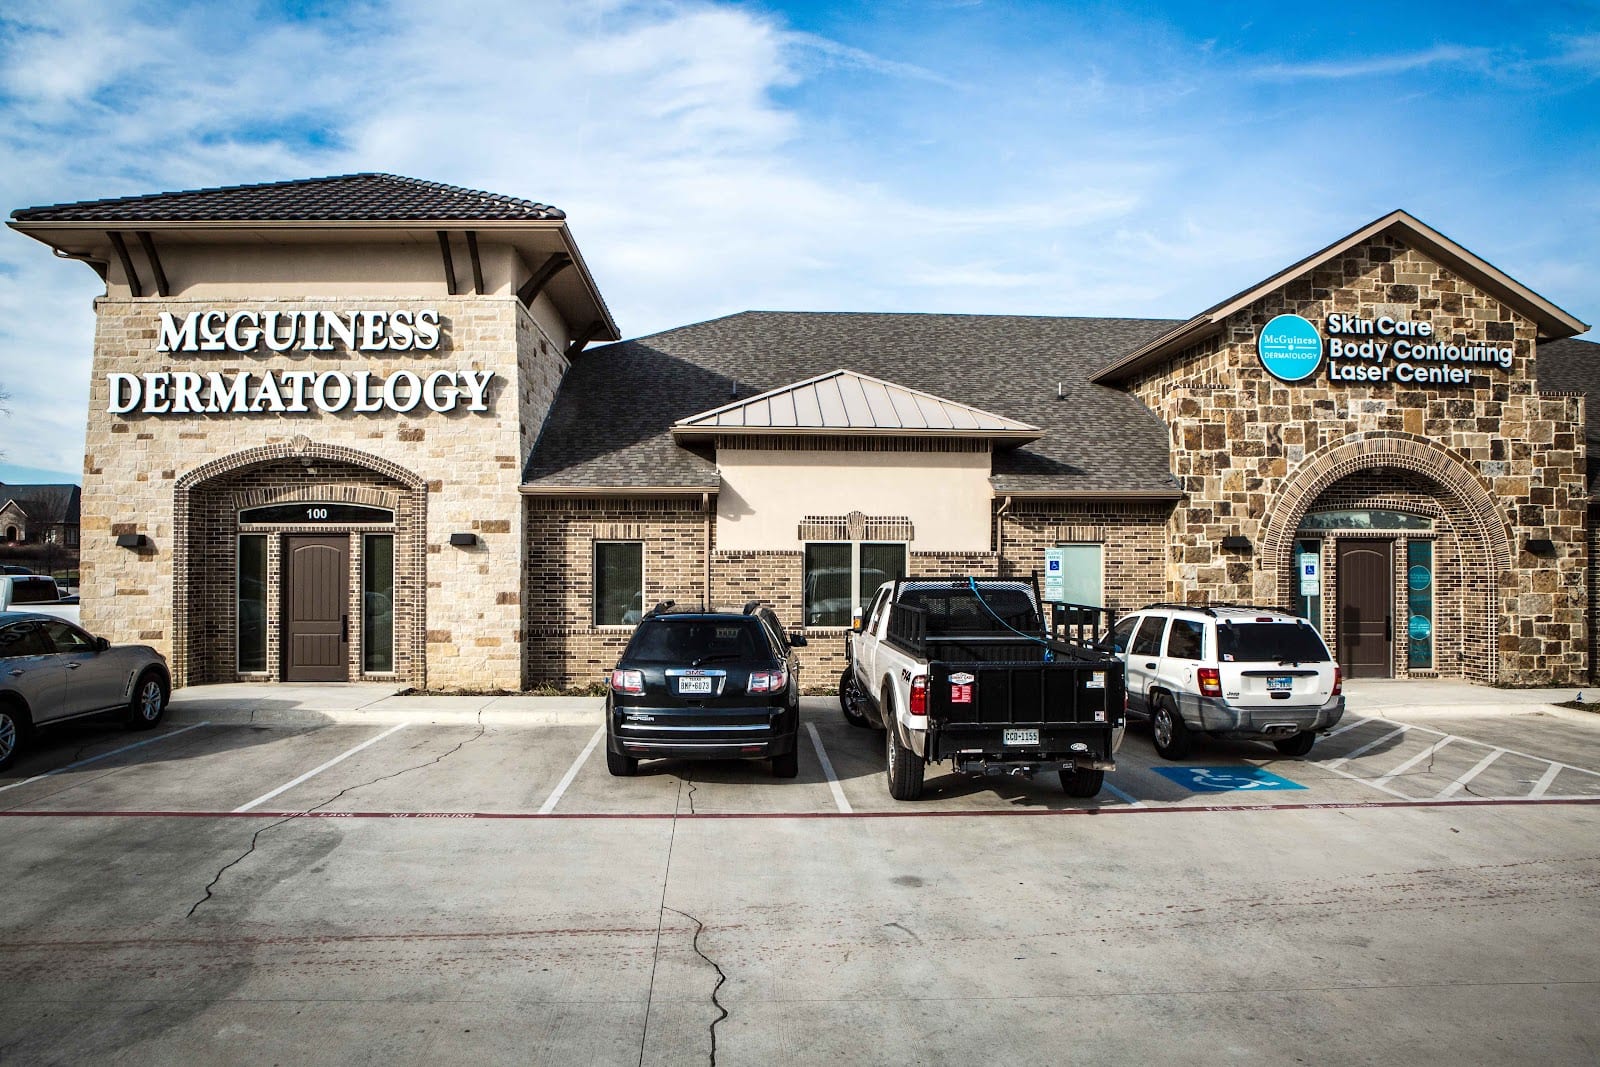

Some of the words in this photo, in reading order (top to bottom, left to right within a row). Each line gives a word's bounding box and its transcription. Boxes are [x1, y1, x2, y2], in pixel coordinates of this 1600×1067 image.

[1328, 313, 1374, 334] Skin
[1377, 315, 1432, 337] Care
[1264, 334, 1317, 345] McGuiness
[1264, 351, 1318, 360] DERMATOLOGY
[1329, 337, 1388, 363] Body
[1393, 339, 1513, 368] Contouring
[1330, 360, 1391, 381] Laser
[1396, 362, 1472, 384] Center
[106, 369, 497, 415] DERMATOLOGY
[306, 508, 328, 519] 100
